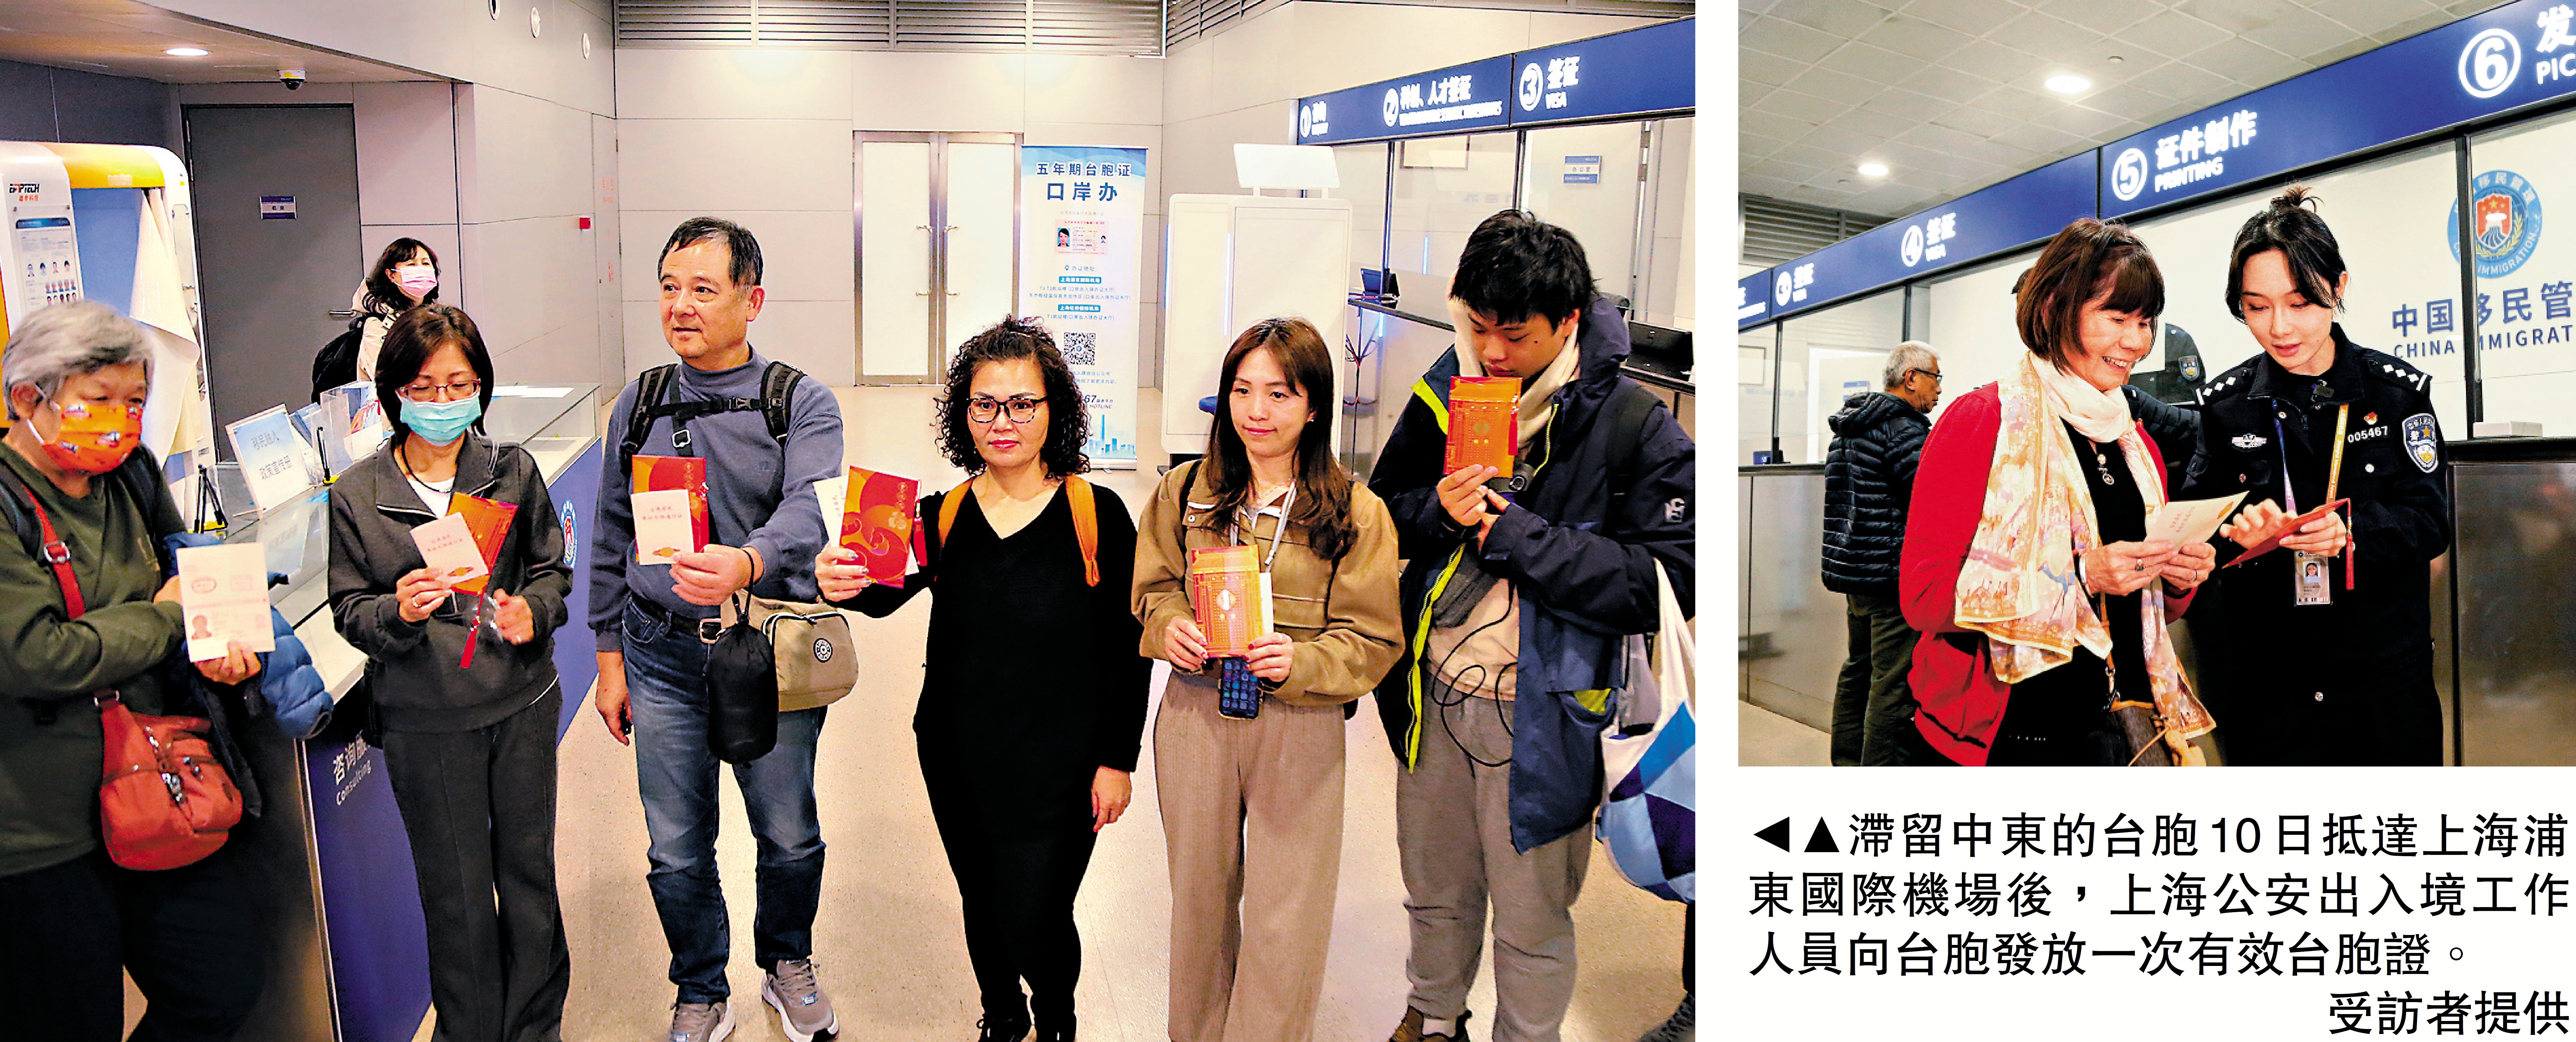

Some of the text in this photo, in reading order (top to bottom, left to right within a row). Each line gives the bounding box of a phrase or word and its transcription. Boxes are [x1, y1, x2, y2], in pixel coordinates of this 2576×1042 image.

[2536, 4, 2576, 53] 发
[2536, 53, 2576, 84] PIC
[1037, 163, 1131, 177] 五年期台胞证
[2154, 157, 2223, 192] PRINTING
[1047, 182, 1118, 201] 口岸办
[2393, 340, 2455, 358] CHINA
[2347, 425, 2388, 443] 005467
